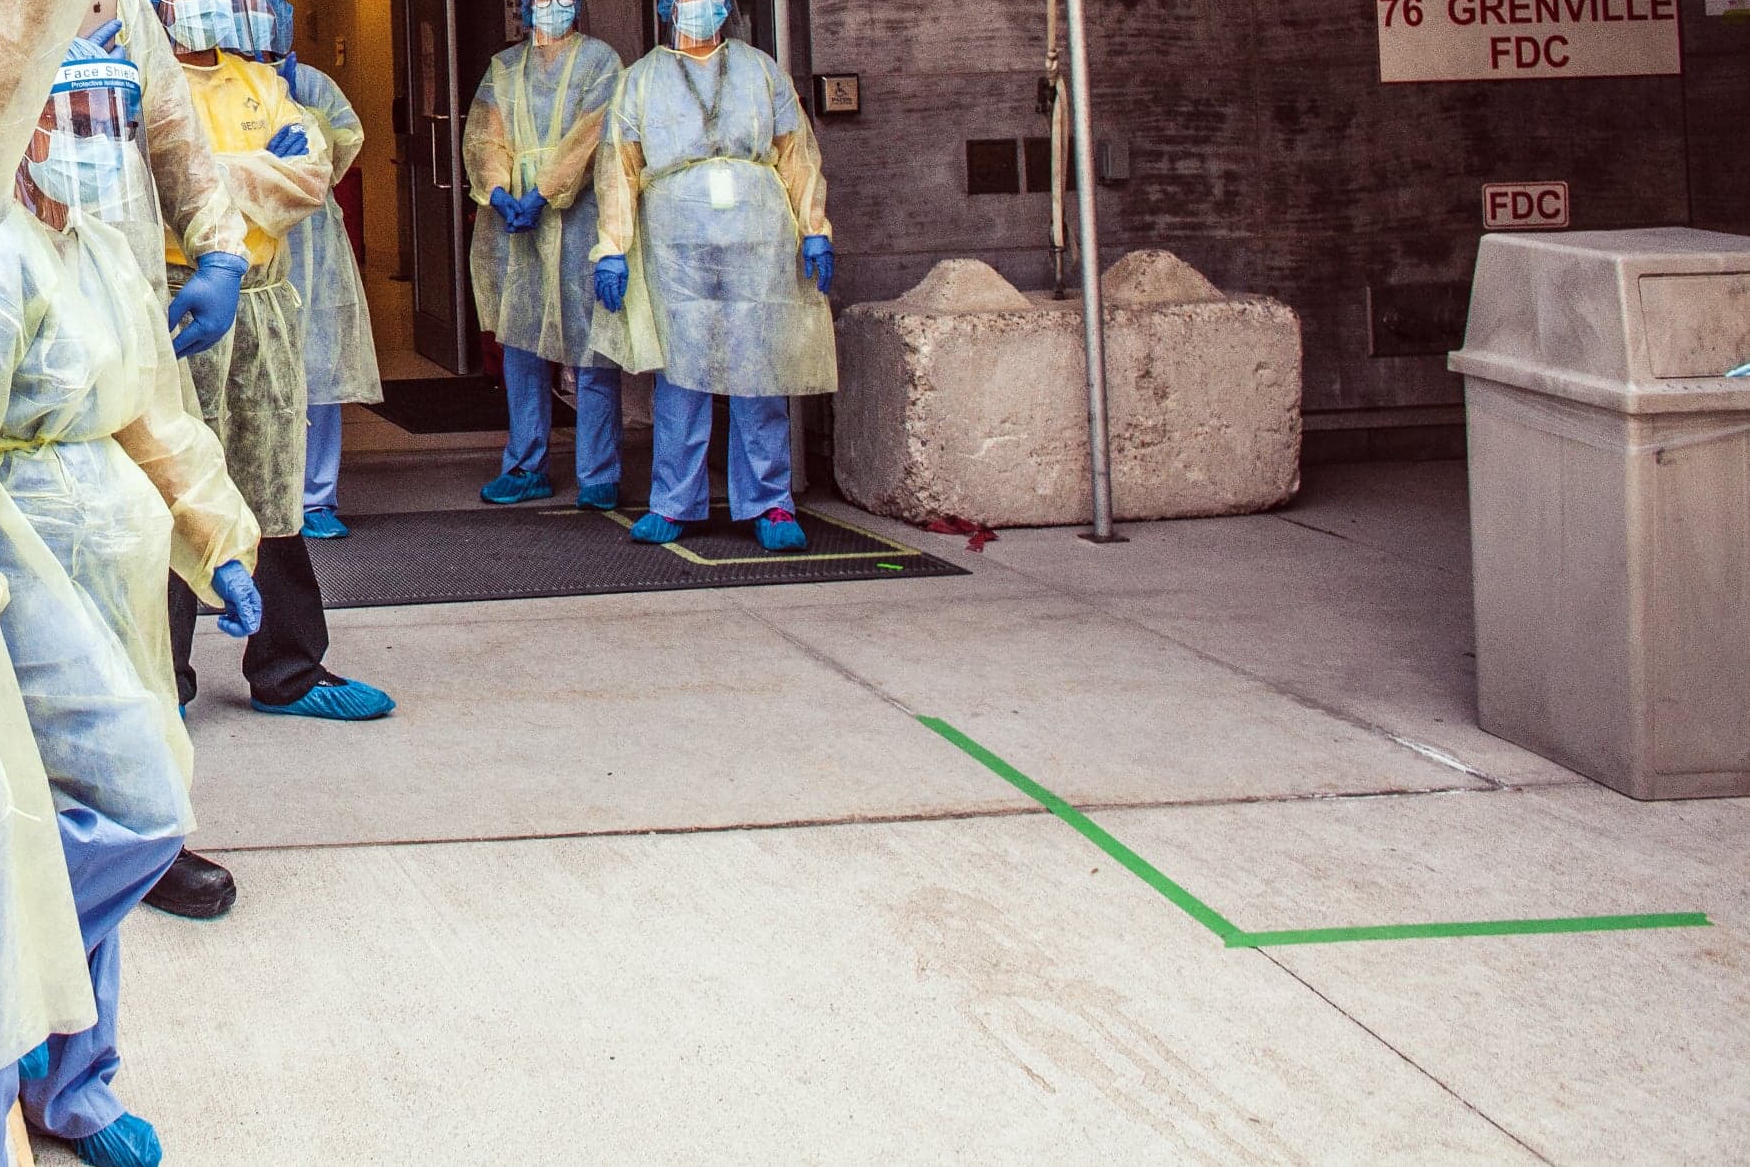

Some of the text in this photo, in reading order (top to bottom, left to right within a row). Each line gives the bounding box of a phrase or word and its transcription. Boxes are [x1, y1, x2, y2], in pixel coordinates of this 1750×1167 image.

[1490, 34, 1570, 70] FDC
[64, 67, 99, 81] Face
[1489, 189, 1561, 221] FDC
